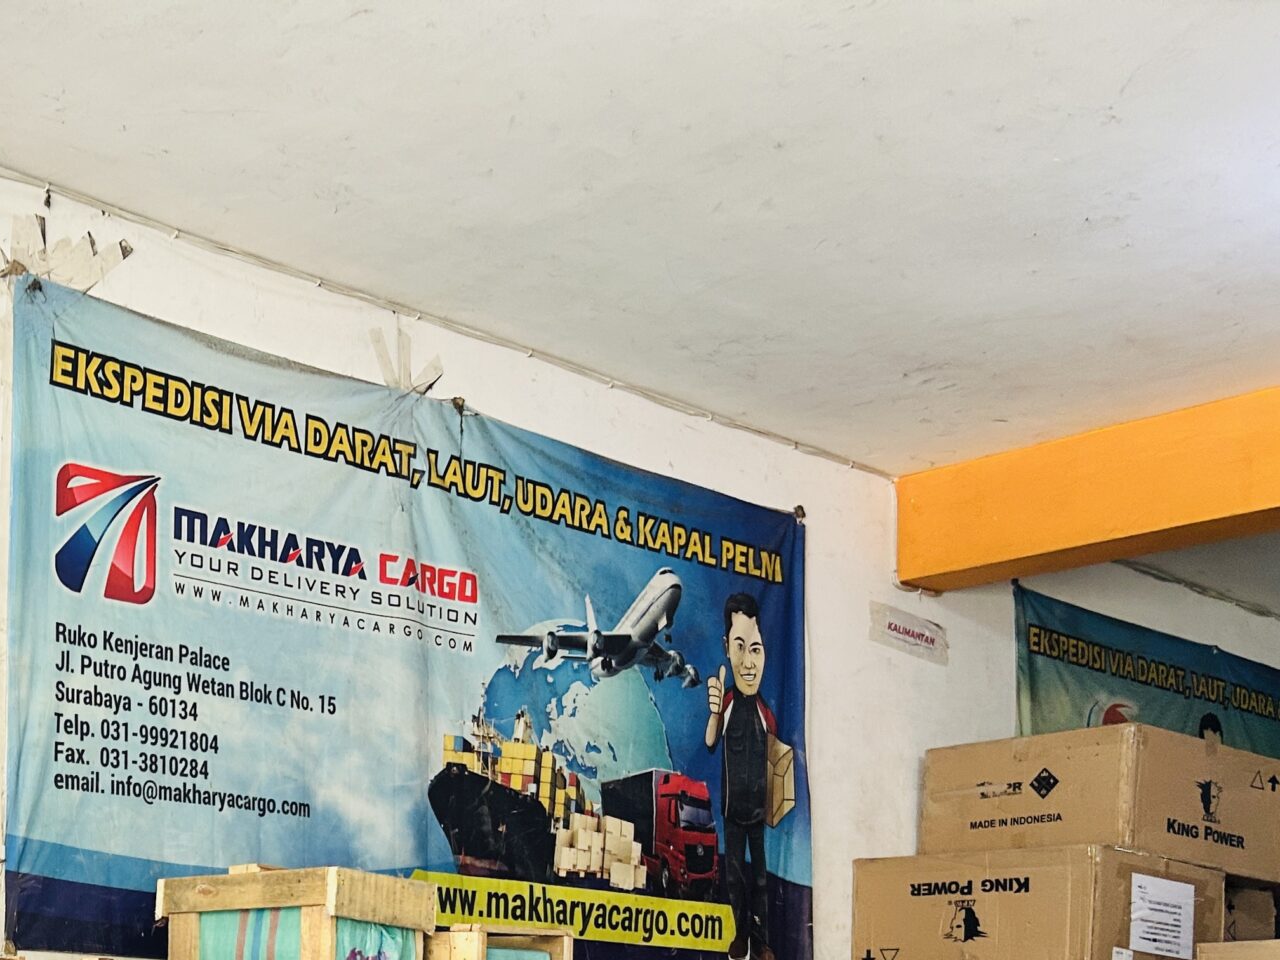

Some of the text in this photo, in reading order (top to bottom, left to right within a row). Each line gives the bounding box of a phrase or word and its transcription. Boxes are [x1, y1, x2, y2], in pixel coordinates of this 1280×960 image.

[50, 339, 233, 434] EKSPEDISI
[236, 394, 302, 454] VIA
[305, 414, 426, 488] DARAT,
[427, 449, 514, 513] LAUT,
[514, 476, 609, 538] UDARA
[614, 510, 632, 544] &
[637, 513, 717, 569] KAPAL
[173, 507, 478, 604] MAKHARYA CARGO
[174, 550, 478, 626] YOUR DELIVERY SOLUTION
[55, 622, 230, 671] Ruko Kenjeran Palace
[887, 621, 935, 646] KALIMANTAN
[55, 650, 337, 715] Jl. Putro Agung Wetan Blok C No. 15
[1028, 624, 1106, 672] EKSPEDISI
[1108, 649, 1136, 681] VIA
[1231, 684, 1276, 719] UDARA
[55, 680, 132, 715] Surabaya
[148, 695, 199, 721] 60134
[54, 712, 219, 754] Telp. 031-99921804
[54, 741, 209, 780] Fax. 031-3810284
[54, 771, 311, 819] email. info@makharyacargo.com
[970, 812, 1063, 830] MADE IN INDONESIA
[437, 884, 724, 942] ww.makharyacargo.com
